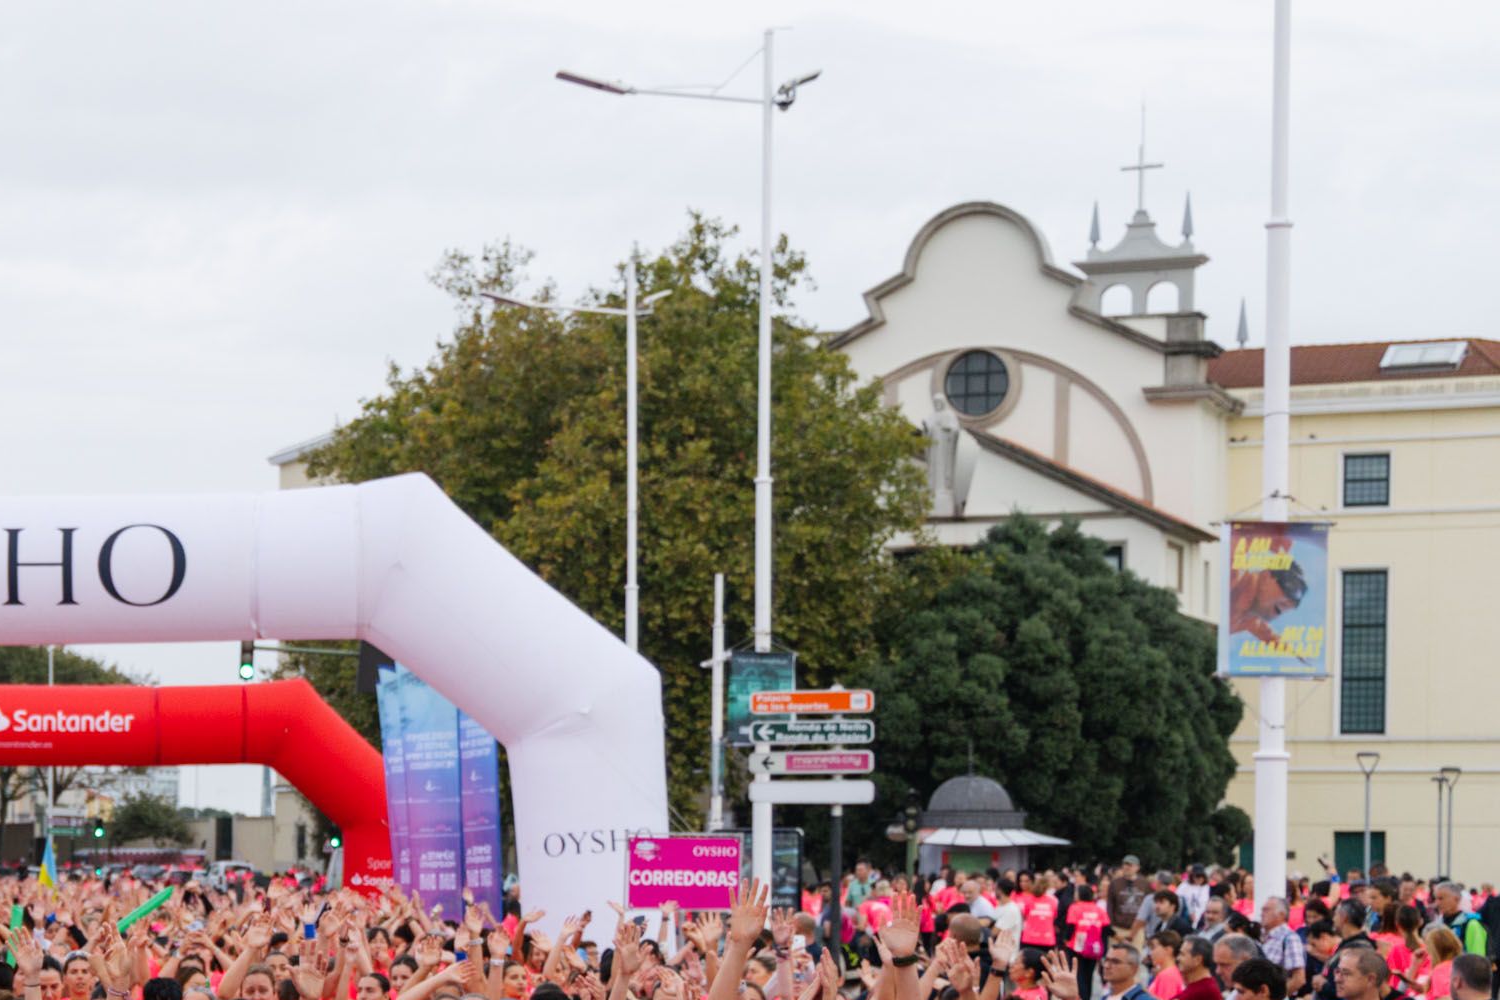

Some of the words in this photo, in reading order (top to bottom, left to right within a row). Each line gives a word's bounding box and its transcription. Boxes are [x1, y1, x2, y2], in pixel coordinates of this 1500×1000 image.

[12, 709, 134, 733] Santander
[692, 845, 737, 858] OYSHO
[629, 869, 738, 888] CORREDORAS
